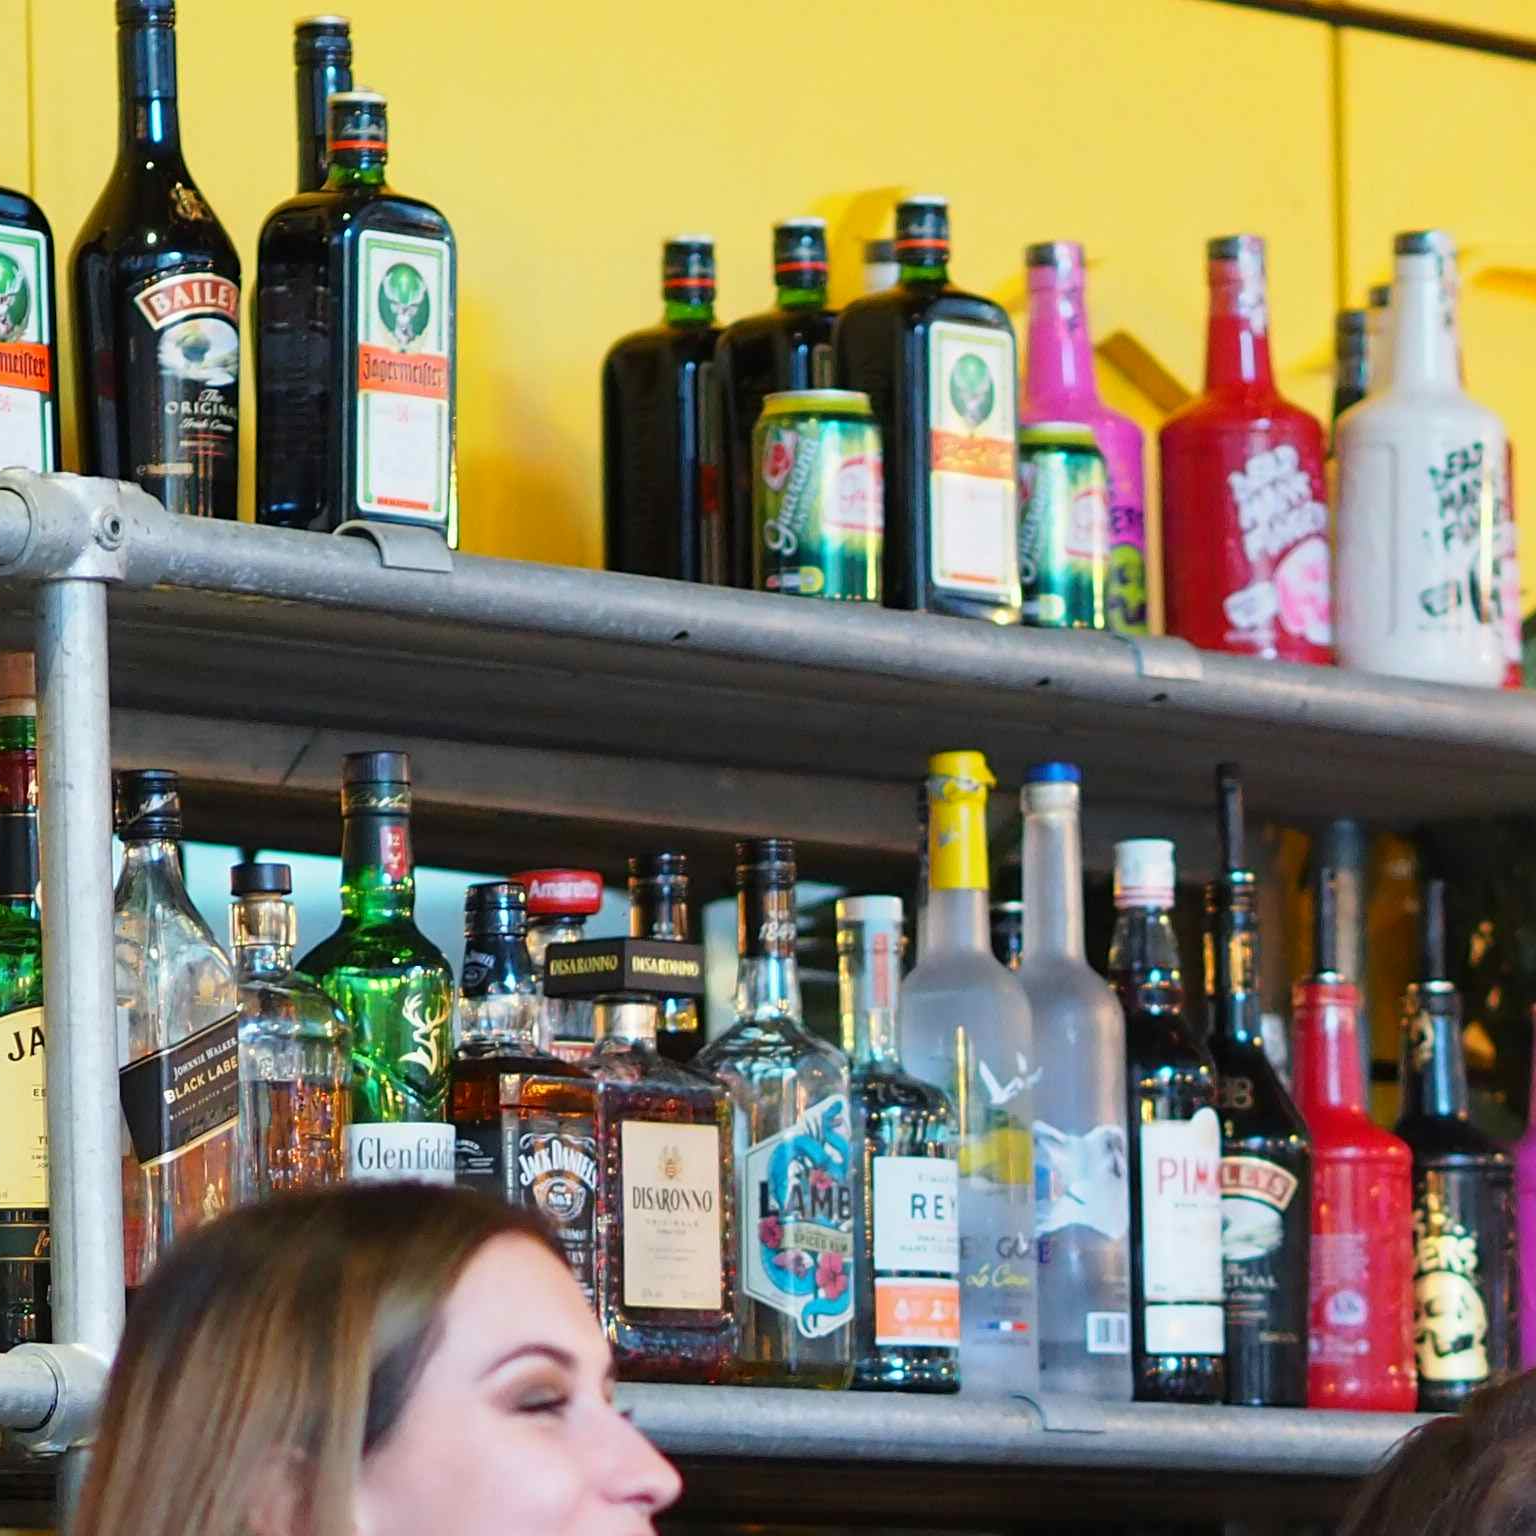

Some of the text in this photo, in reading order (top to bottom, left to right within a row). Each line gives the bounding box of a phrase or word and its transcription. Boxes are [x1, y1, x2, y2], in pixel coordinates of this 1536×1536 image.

[549, 955, 619, 977] DISARONNO
[7, 1025, 46, 1062] JA
[163, 1055, 239, 1105] BLACK LABE
[632, 1186, 713, 1213] DISARONNO
[759, 1180, 852, 1220] LAMB
